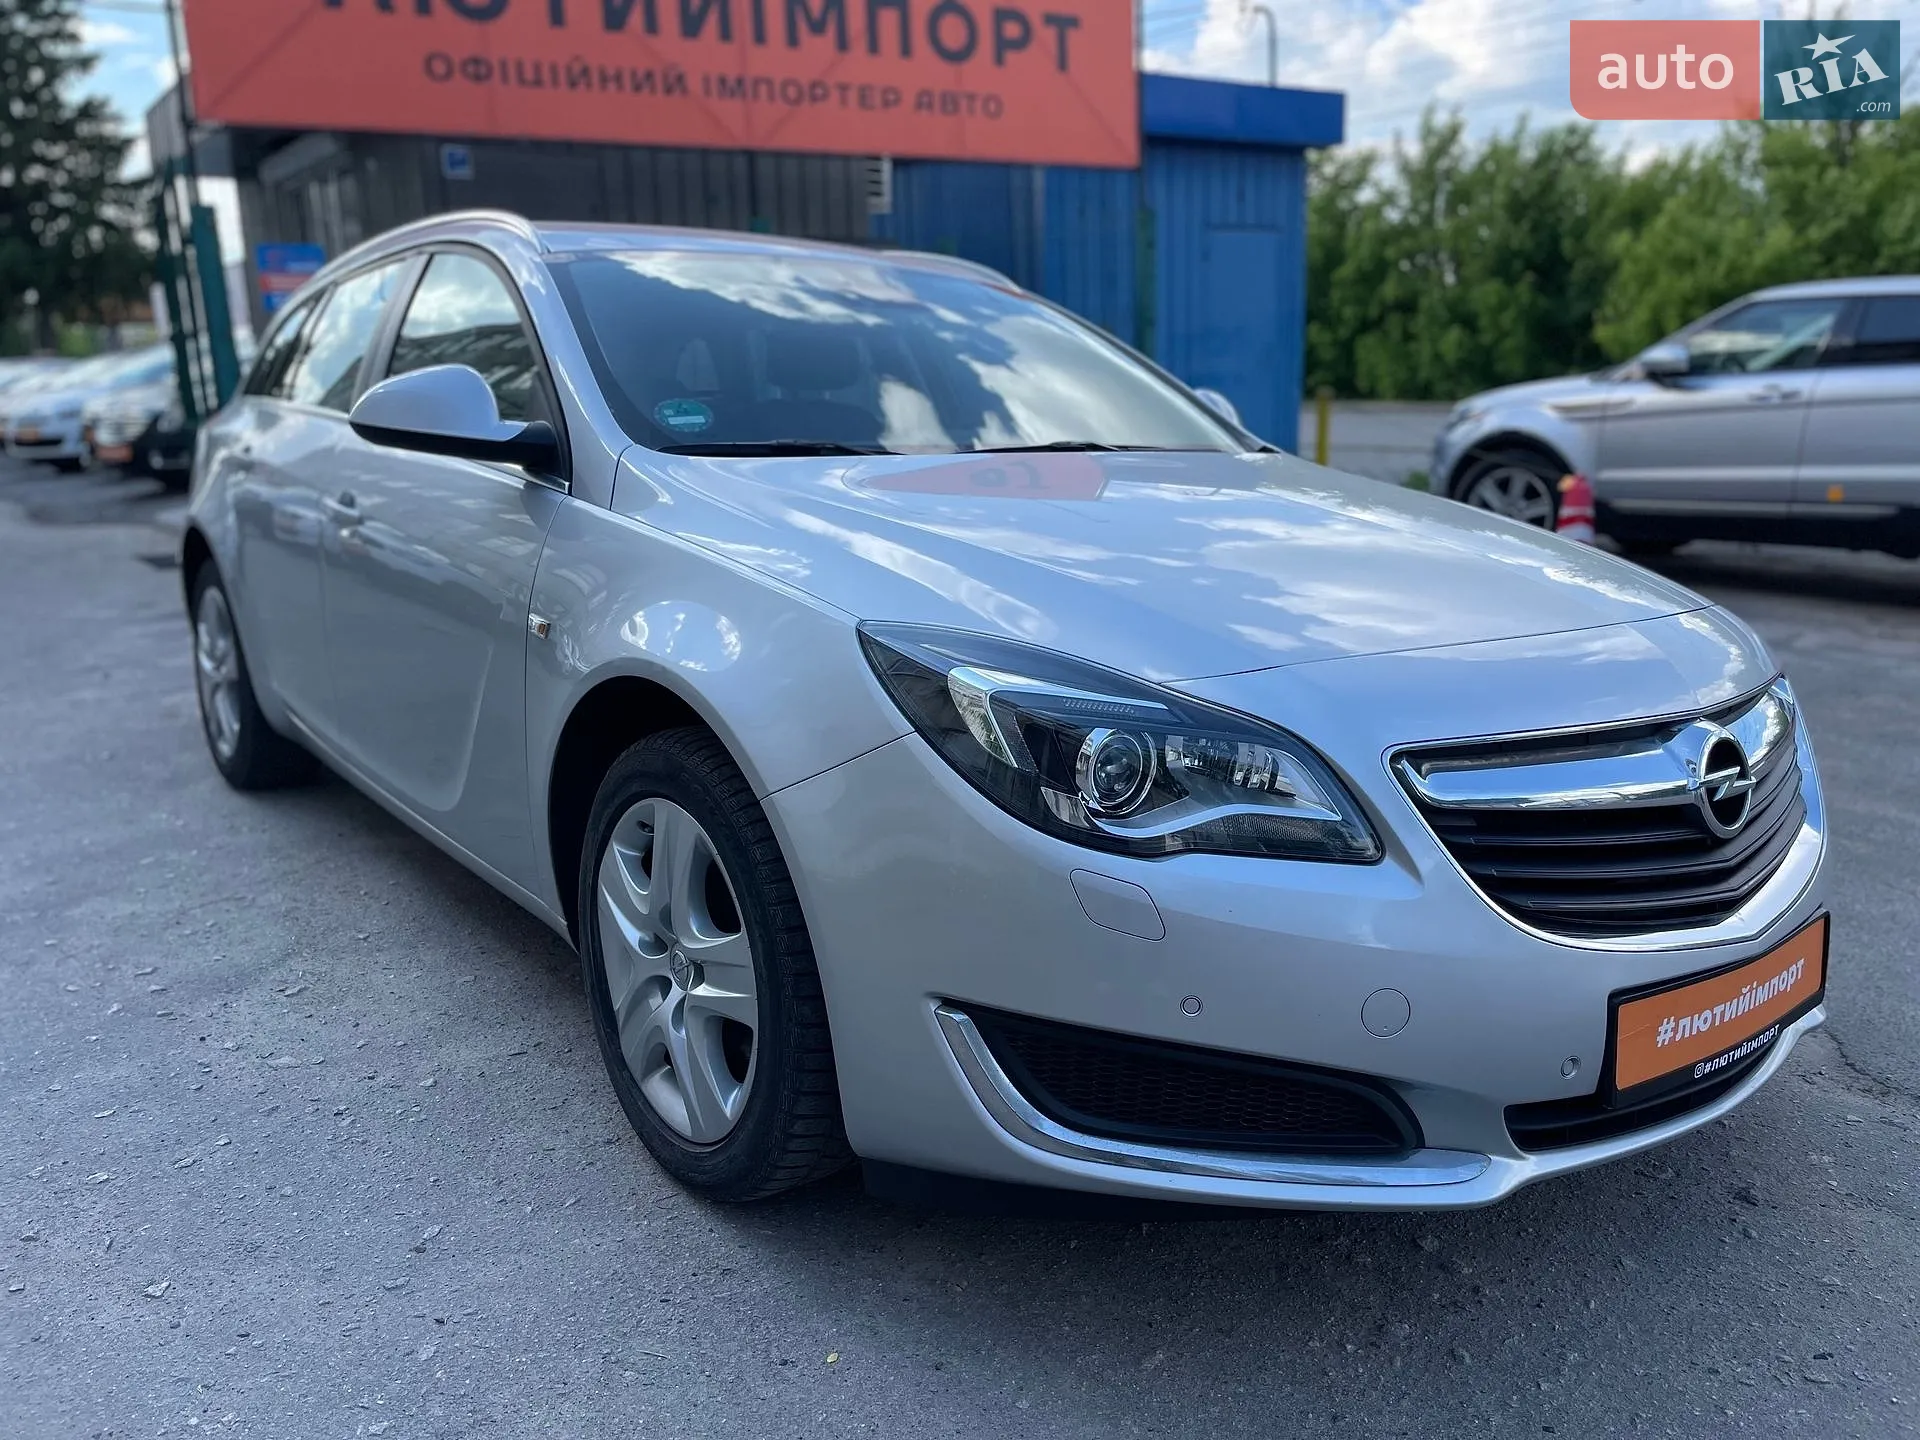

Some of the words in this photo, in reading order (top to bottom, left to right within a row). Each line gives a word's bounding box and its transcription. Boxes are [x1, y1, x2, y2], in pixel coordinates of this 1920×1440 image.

[322, 0, 1080, 74] ИІМПОРТ
[422, 51, 690, 97] ОФІЦІЙНИЙ
[702, 73, 904, 112] ІМПОРТЕР
[913, 88, 1004, 120] АВТО
[1656, 957, 1805, 1048] #лютийімпорт
